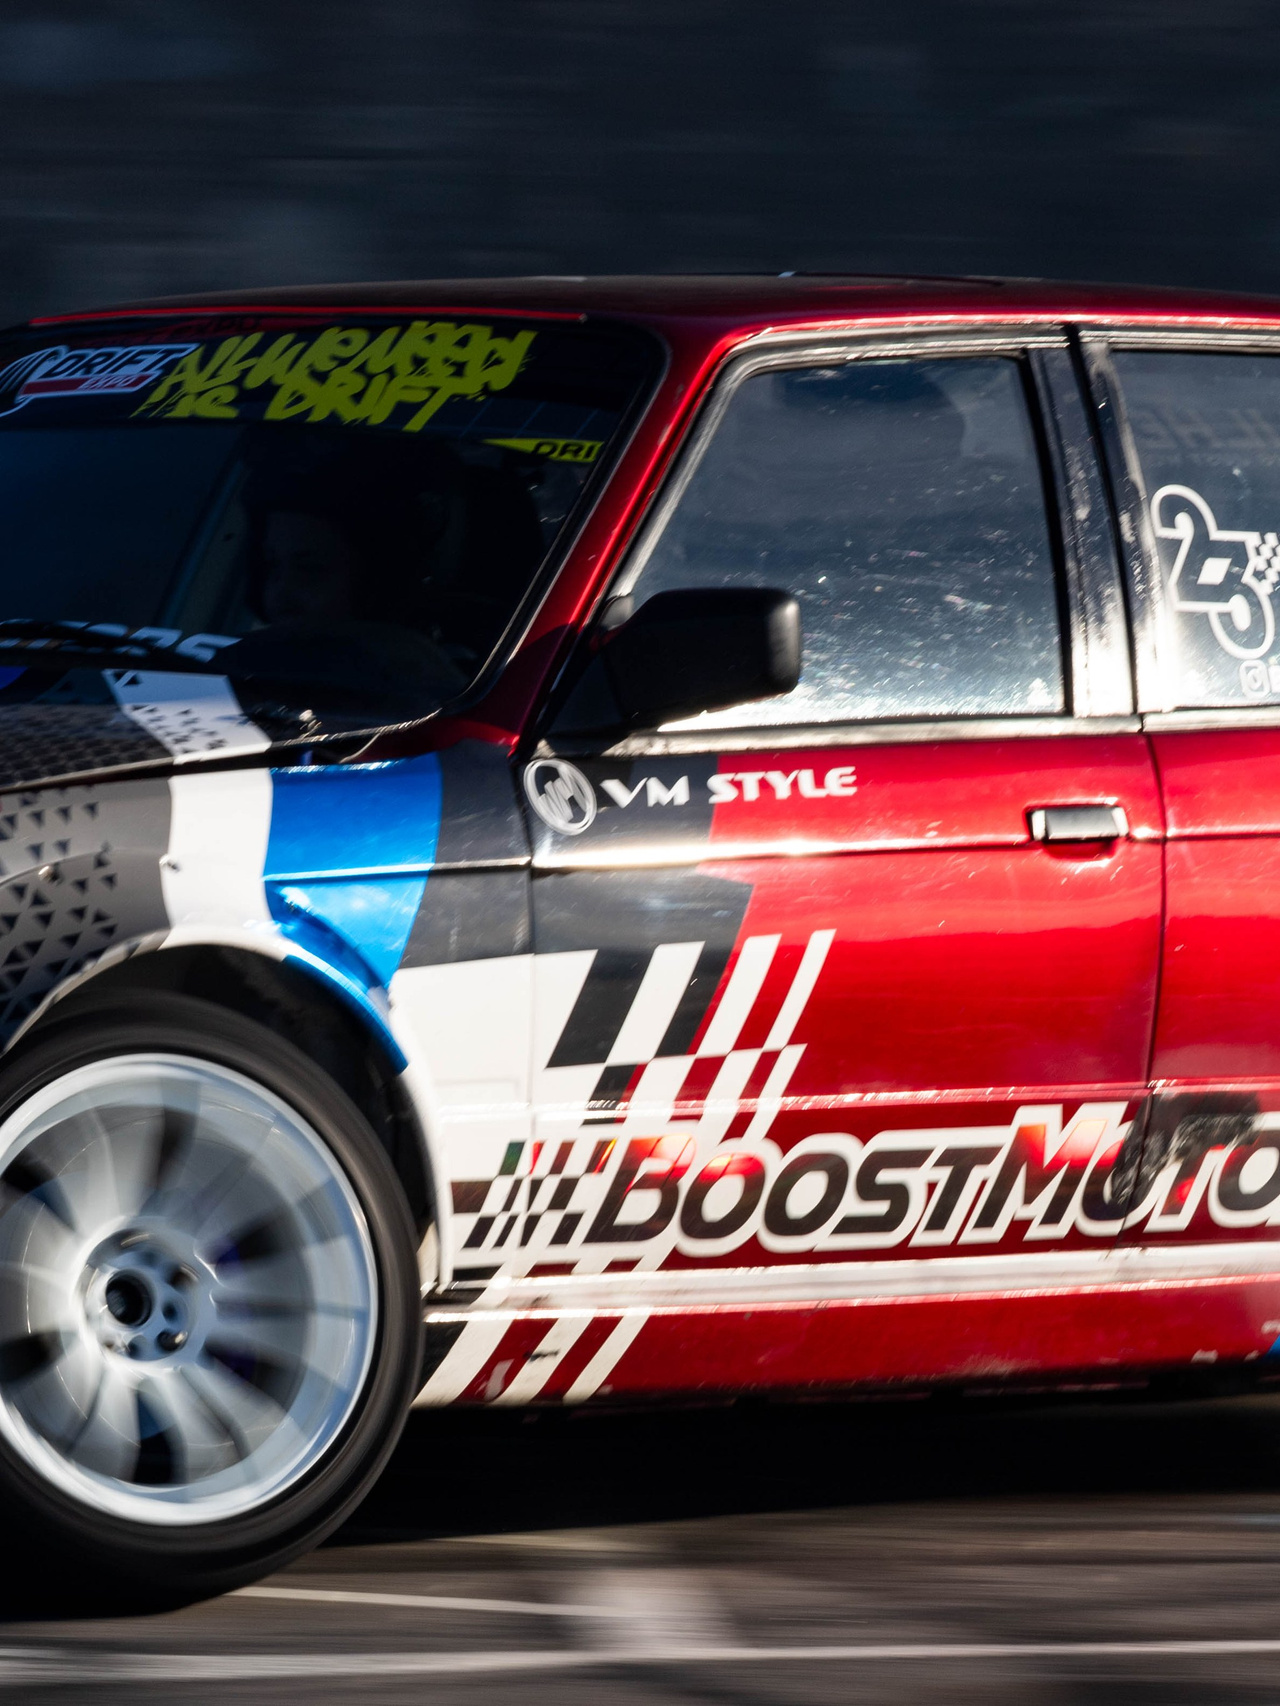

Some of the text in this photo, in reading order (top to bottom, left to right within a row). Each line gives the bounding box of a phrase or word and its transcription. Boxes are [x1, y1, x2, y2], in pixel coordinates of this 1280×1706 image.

[46, 348, 192, 378] DRIFT
[263, 372, 456, 432] DRIFT
[600, 766, 858, 808] VM STYLE
